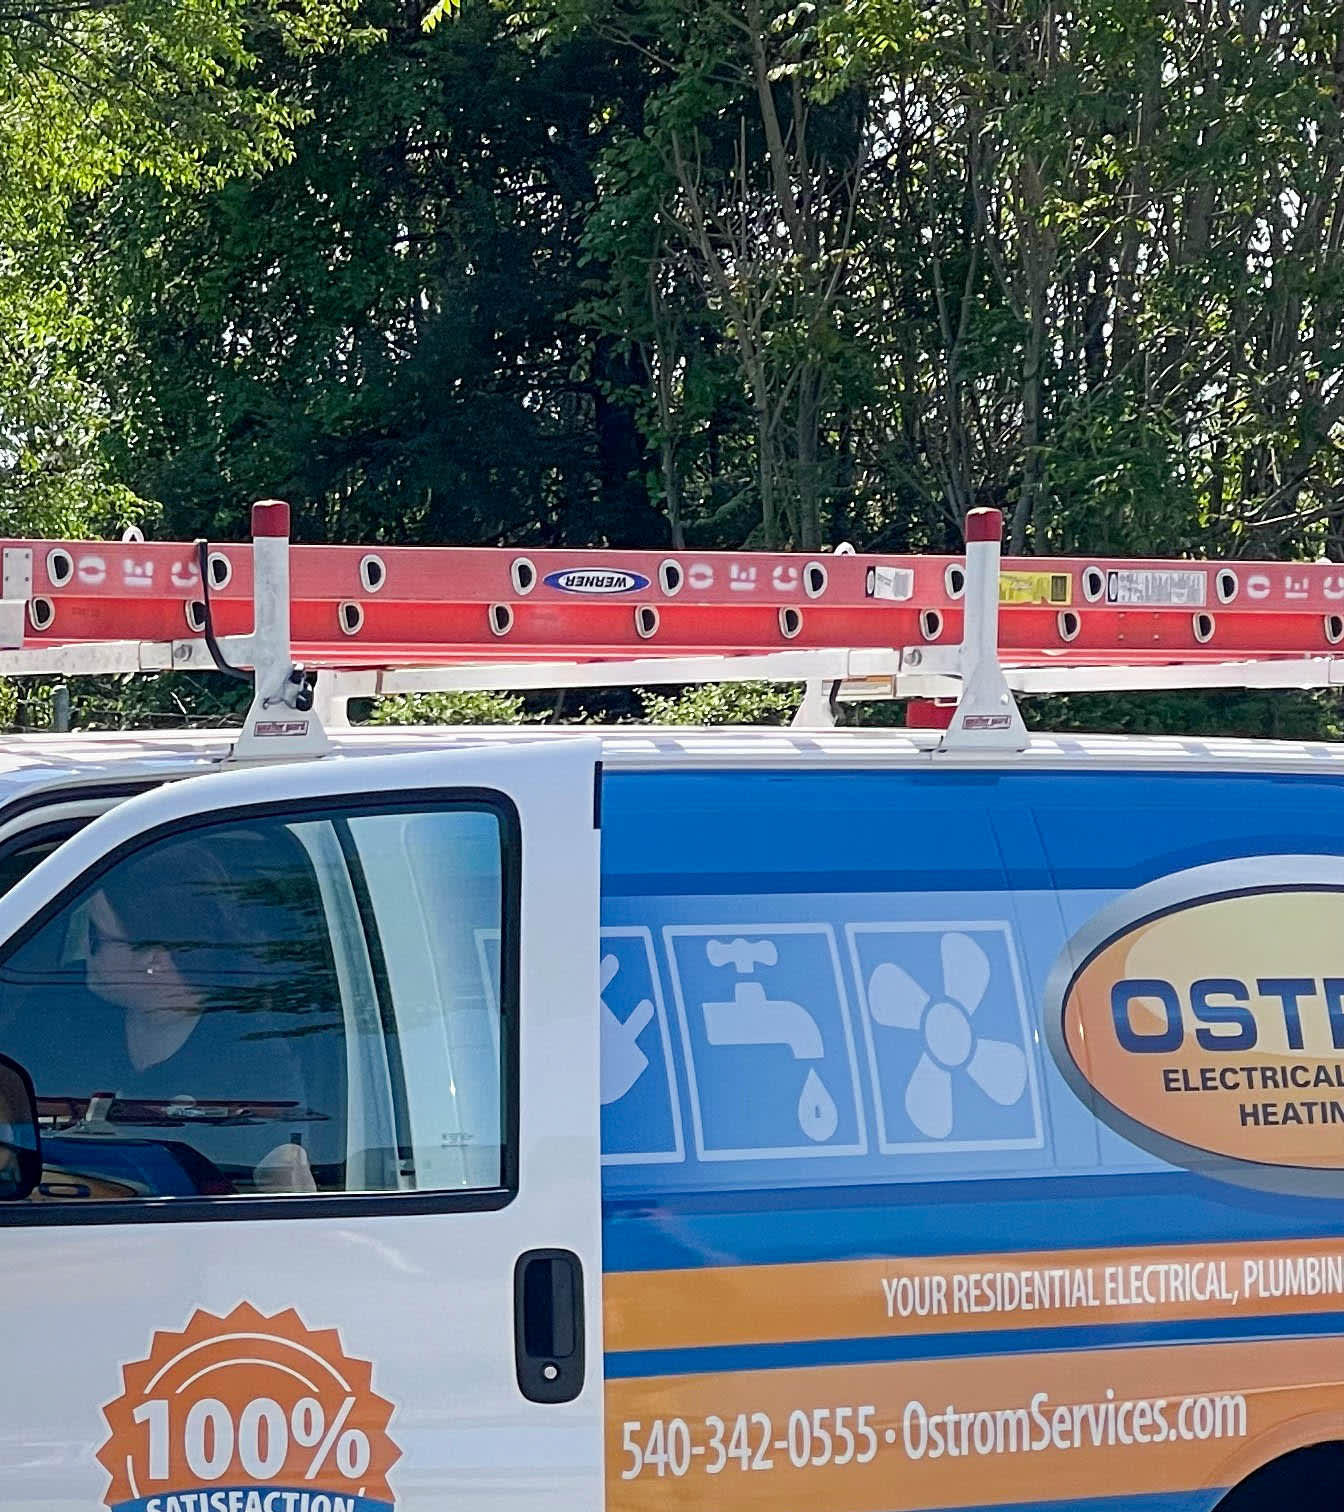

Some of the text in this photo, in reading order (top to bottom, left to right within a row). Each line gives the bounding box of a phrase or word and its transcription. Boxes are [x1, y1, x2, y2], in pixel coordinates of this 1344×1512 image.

[565, 574, 628, 588] WERNER
[881, 1256, 1344, 1318] YOUR RESIDENTIAL ELECTRICAL, PLUMBIN
[132, 1396, 370, 1480] 100%
[622, 1388, 1247, 1480] 540-342-0555 OstromServices.com
